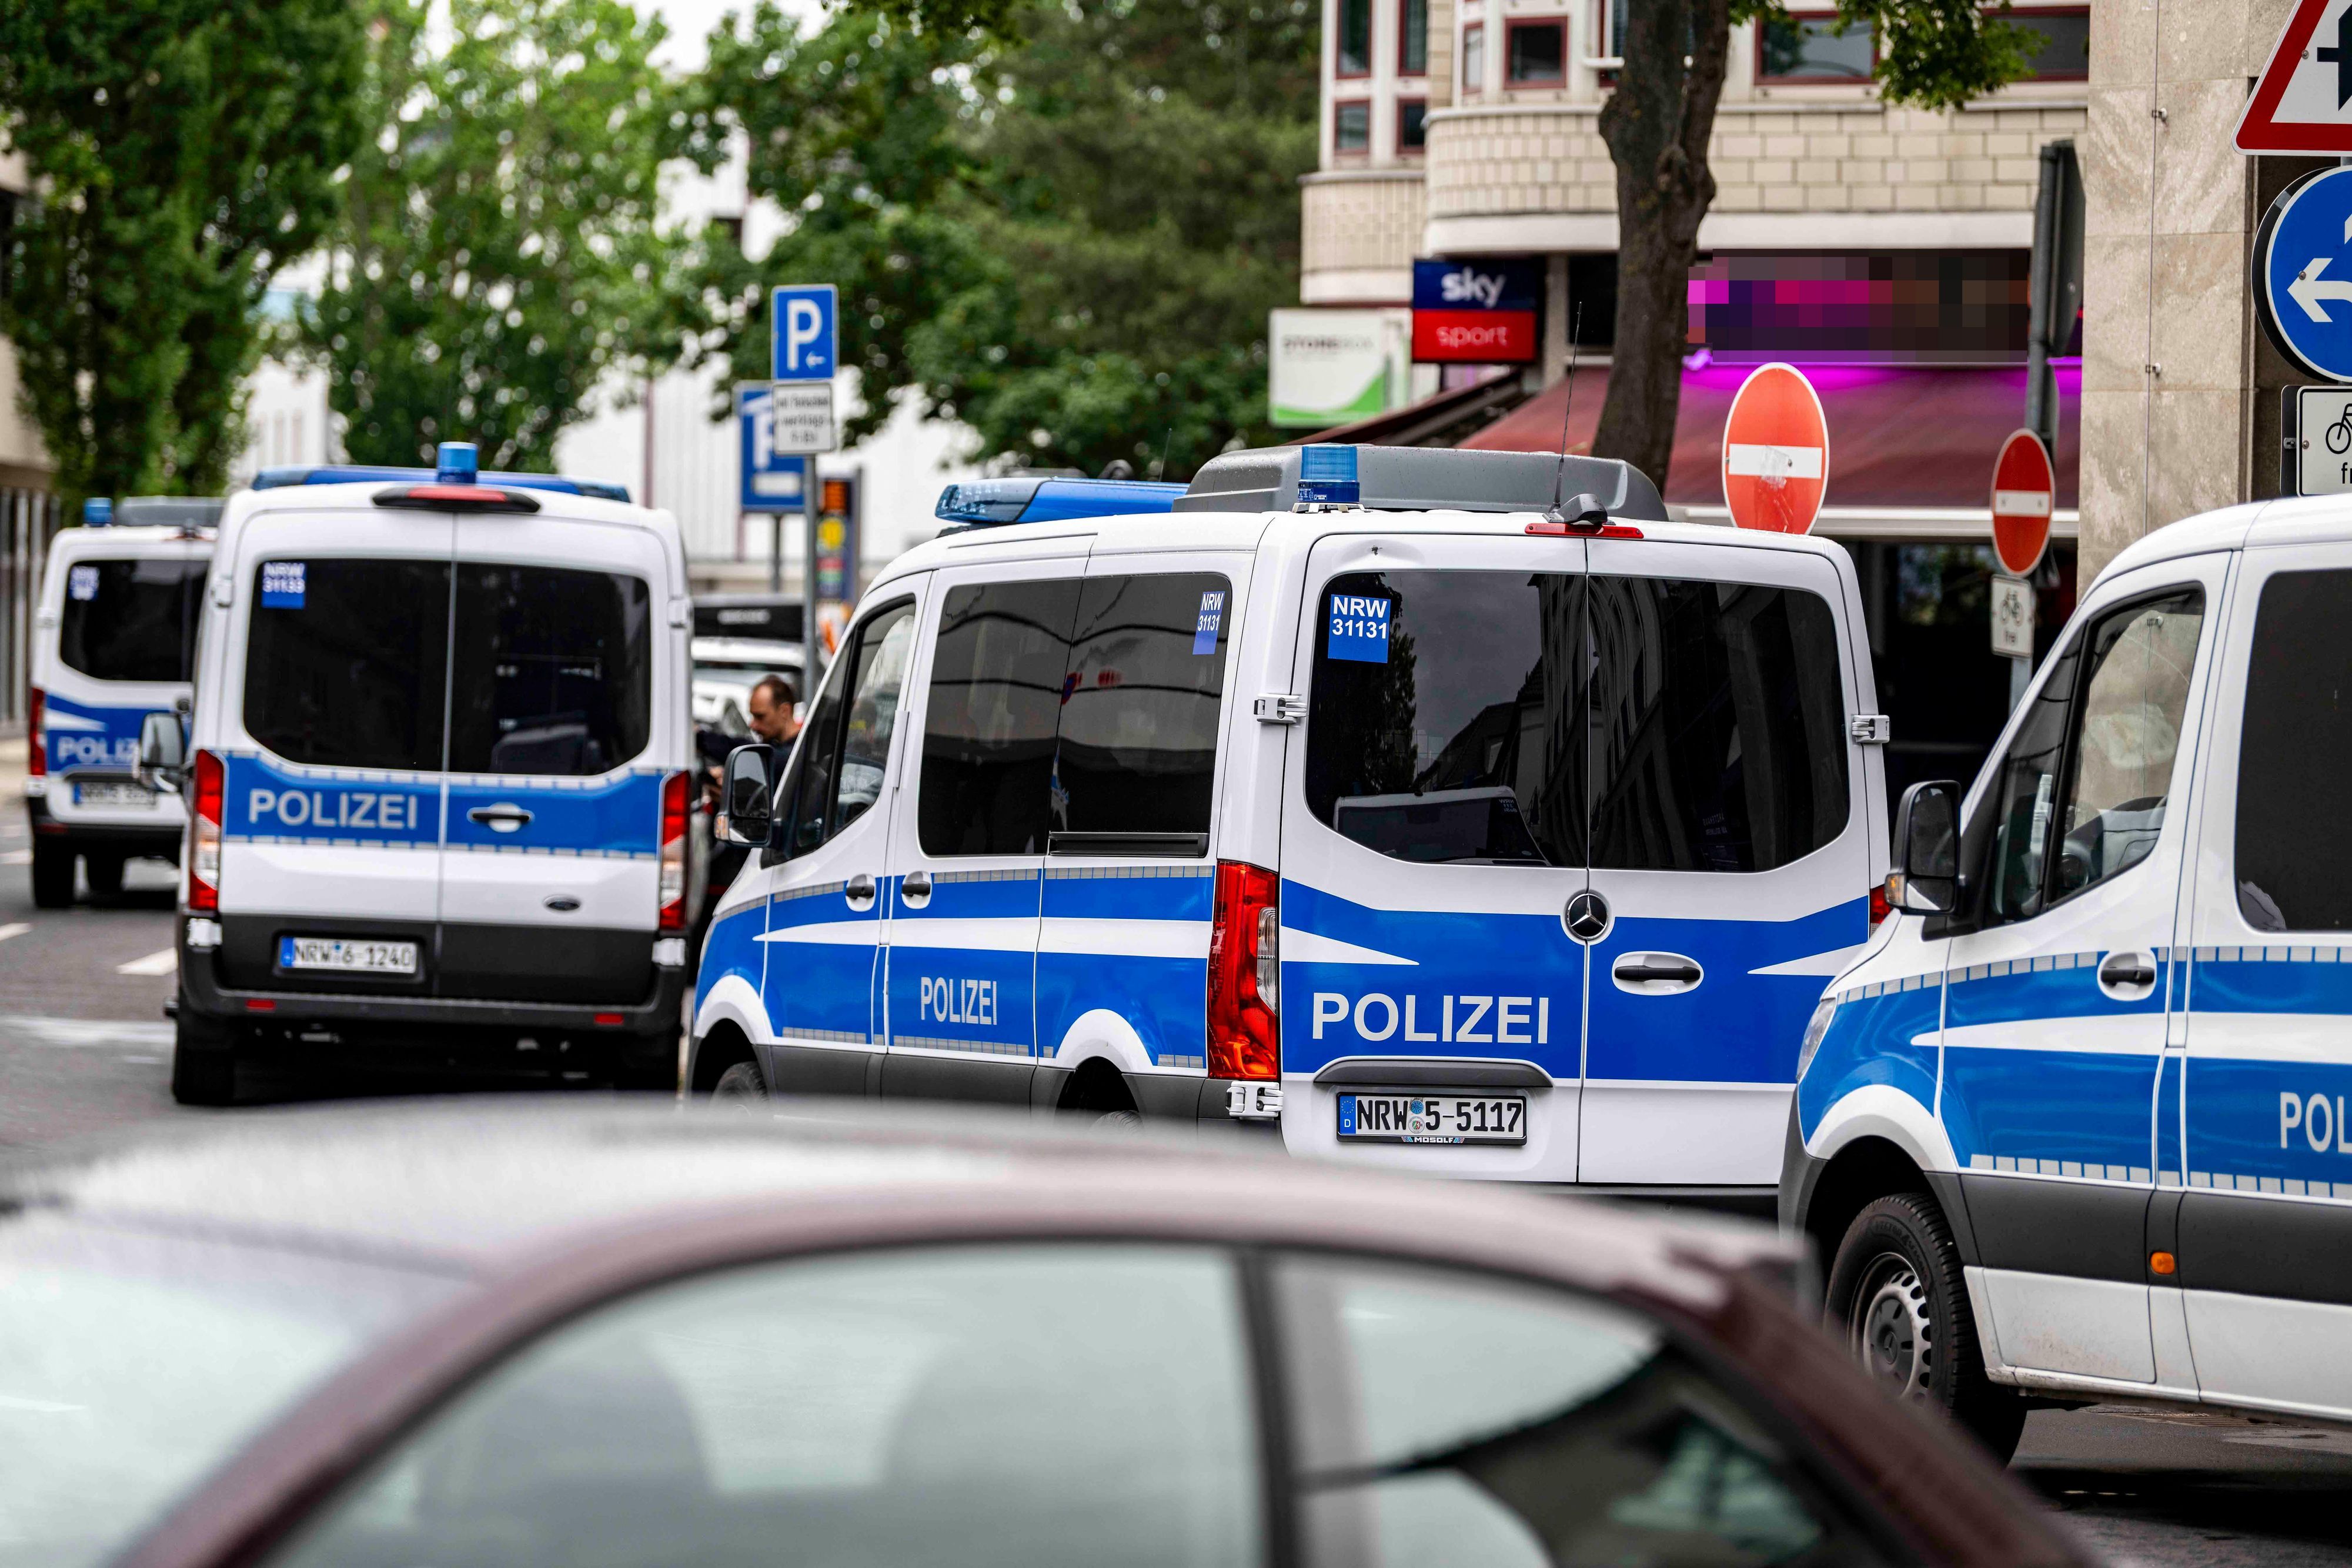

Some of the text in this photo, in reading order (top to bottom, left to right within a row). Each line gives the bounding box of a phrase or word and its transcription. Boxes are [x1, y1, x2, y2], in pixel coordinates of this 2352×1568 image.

[1441, 266, 1506, 309] sky
[787, 299, 823, 371] P
[1436, 326, 1507, 348] sport
[2341, 462, 2352, 484] f
[263, 562, 305, 577] NRW
[1201, 593, 1224, 611] NRW
[1333, 596, 1388, 618] NRW
[1197, 614, 1221, 631] 31131
[1332, 618, 1387, 639] 31131
[248, 788, 418, 830] POLIZEI
[294, 944, 332, 962] NRW
[920, 977, 997, 1025] POLIZEI
[1312, 992, 1549, 1044] POLIZEI
[1344, 1099, 1522, 1132] D NRW 5-5117
